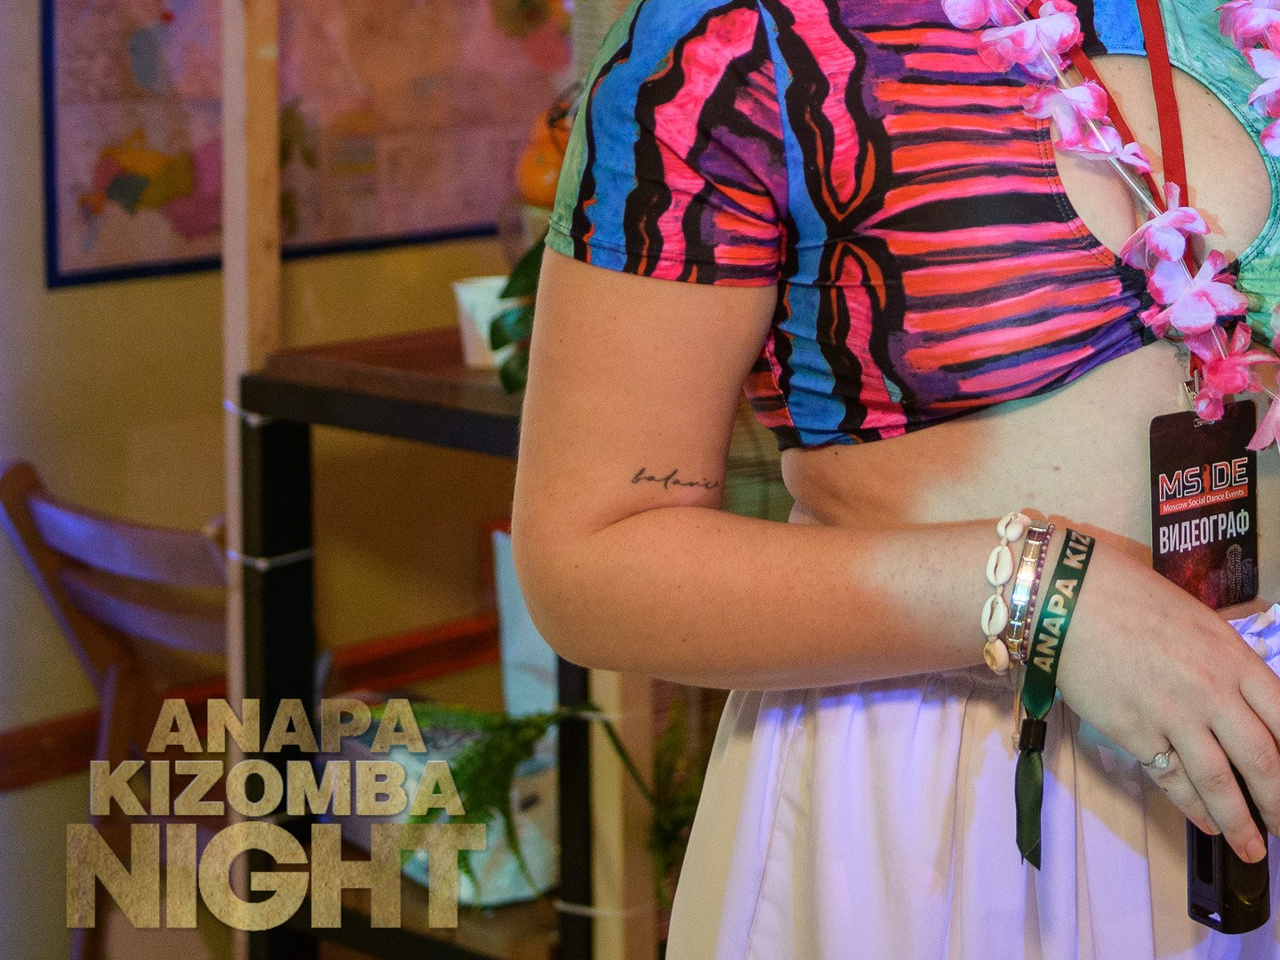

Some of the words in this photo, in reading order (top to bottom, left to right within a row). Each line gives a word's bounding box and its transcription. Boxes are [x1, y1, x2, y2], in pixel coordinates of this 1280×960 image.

[1163, 500, 1188, 512] Moscow
[1188, 496, 1206, 507] Social
[1206, 492, 1225, 503] Dance
[1225, 488, 1245, 499] Events
[1160, 509, 1250, 554] ВИДЕОГРАФ
[1033, 578, 1079, 674] ANAPA
